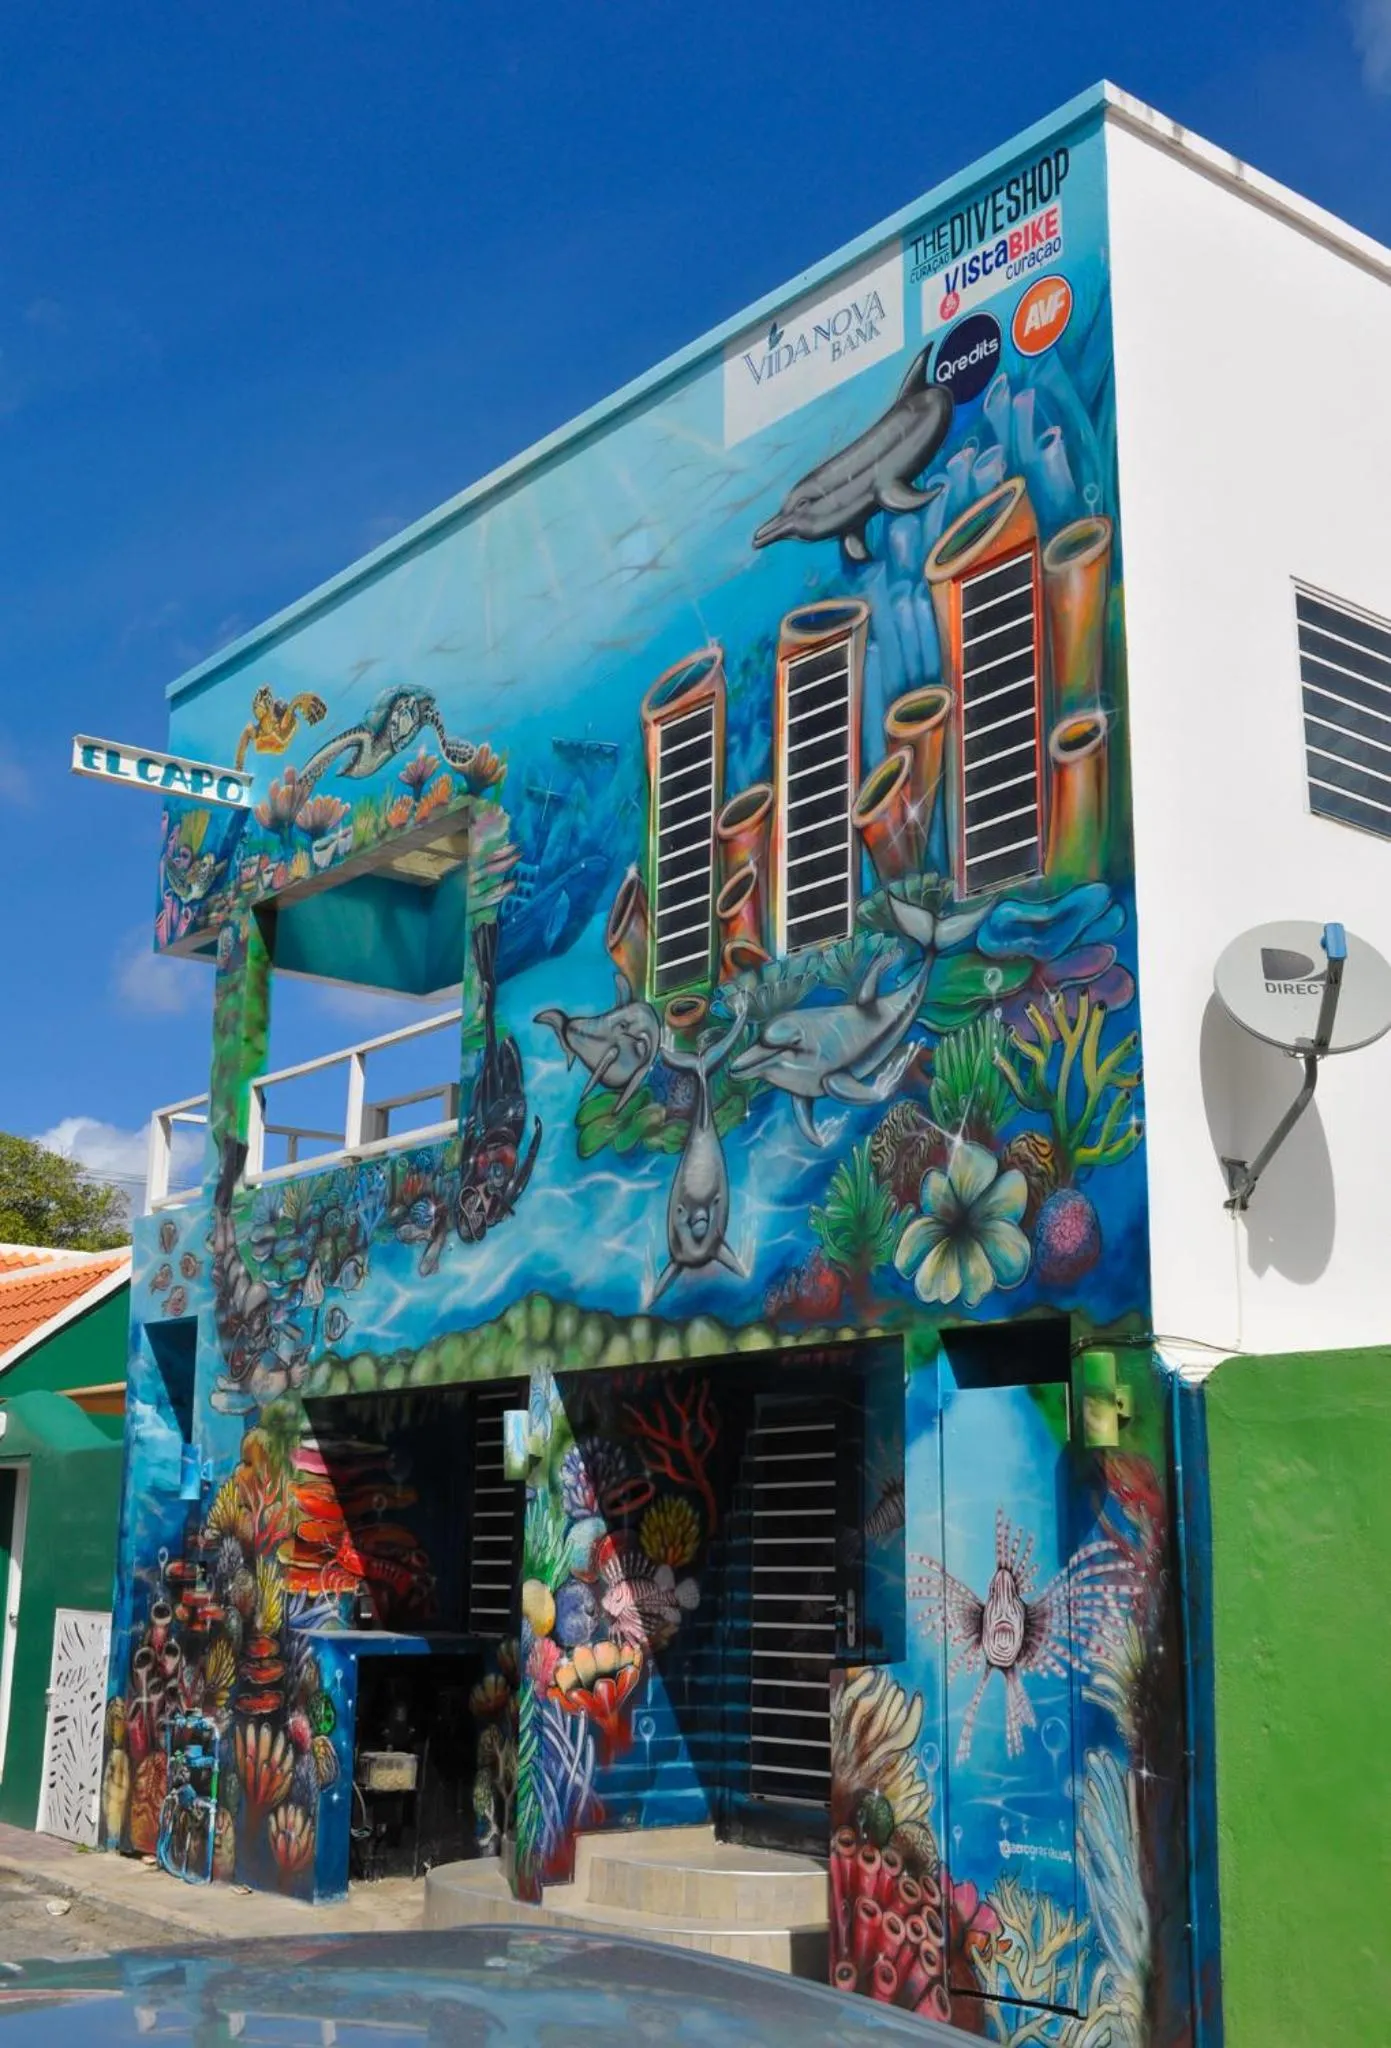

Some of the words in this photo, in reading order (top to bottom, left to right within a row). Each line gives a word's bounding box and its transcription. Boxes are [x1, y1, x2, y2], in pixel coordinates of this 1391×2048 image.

[1006, 237, 1061, 281] curaçao
[1023, 287, 1067, 338] AVF
[831, 320, 881, 362] BANK
[936, 338, 999, 383] Qredits
